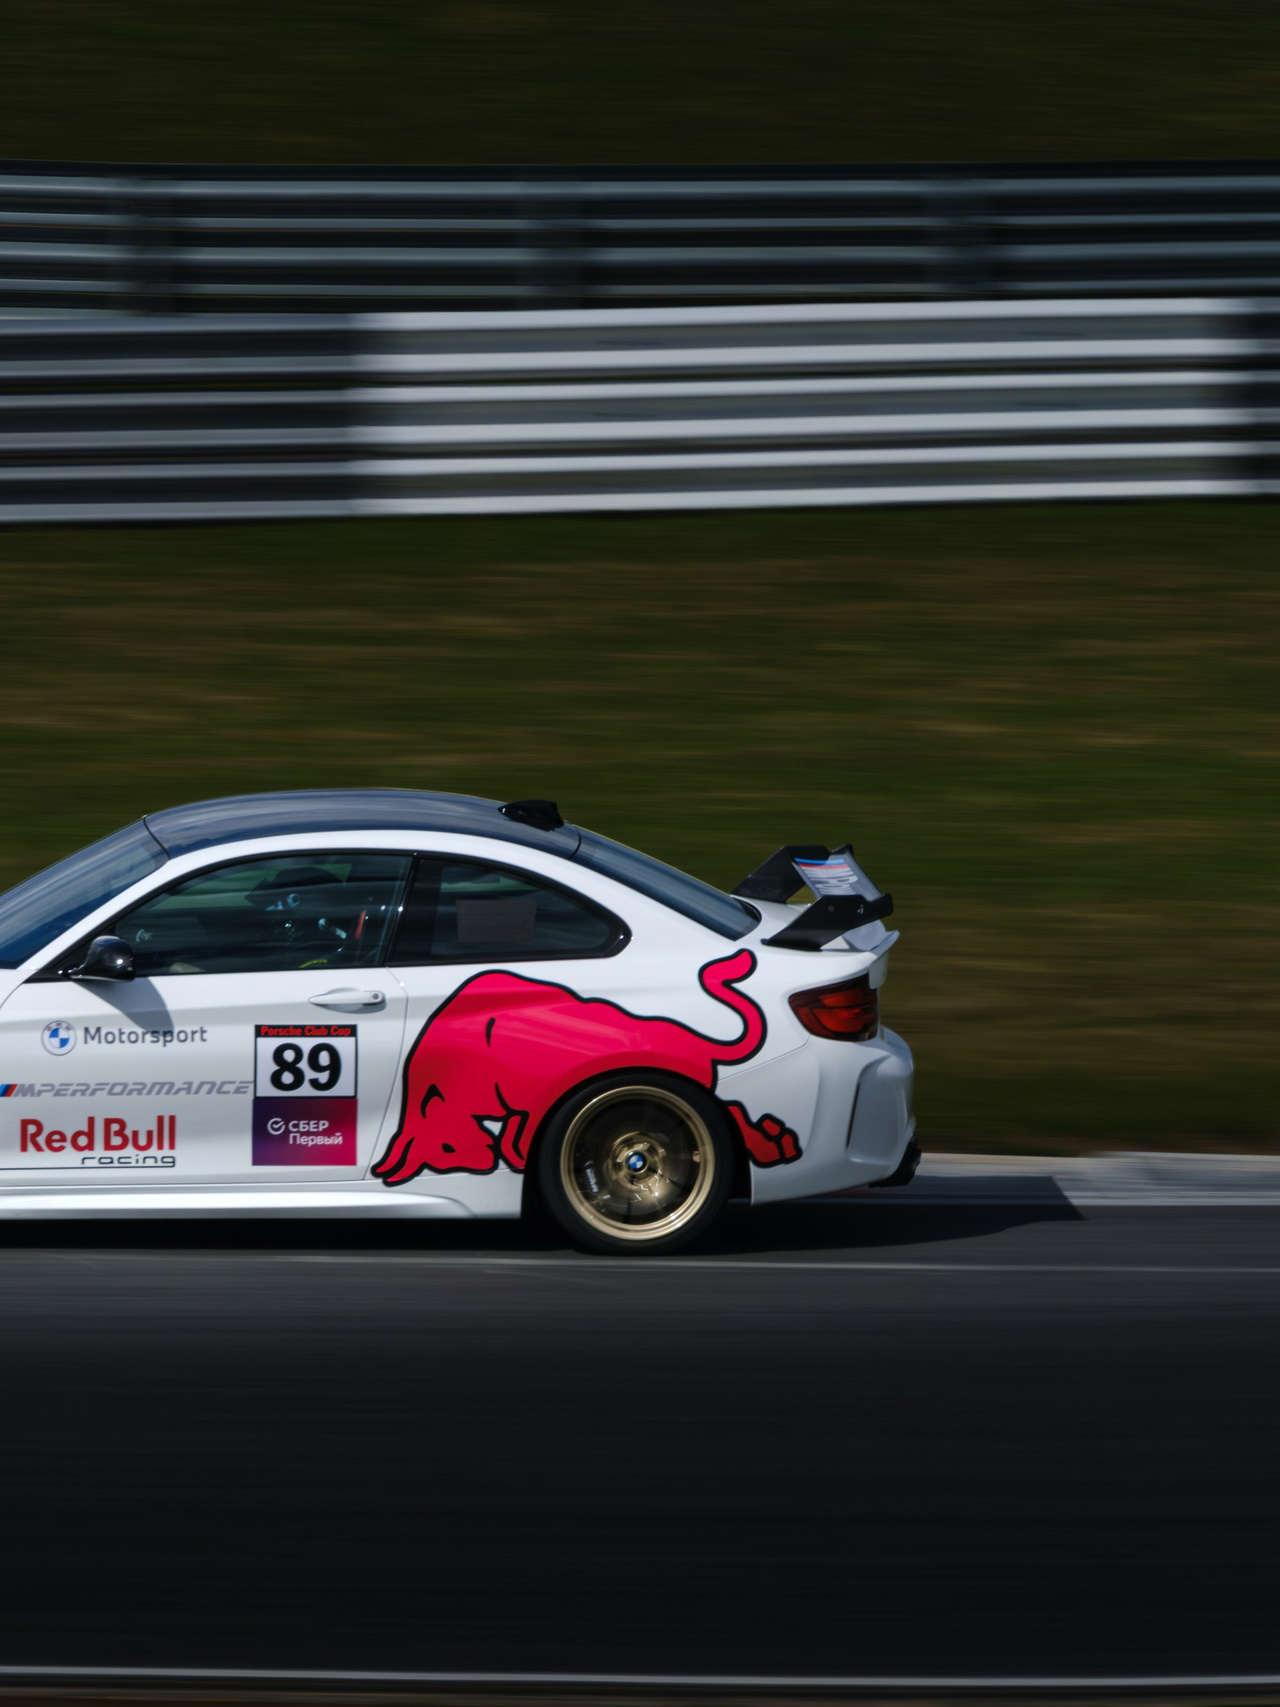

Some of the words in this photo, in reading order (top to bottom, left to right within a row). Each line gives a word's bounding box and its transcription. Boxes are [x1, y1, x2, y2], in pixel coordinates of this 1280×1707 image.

[83, 1026, 208, 1047] Motorsport
[260, 1026, 302, 1036] Porsche
[304, 1025, 328, 1036] Club
[330, 1025, 351, 1037] Cup
[270, 1042, 342, 1091] 89
[288, 1120, 329, 1132] СБЕР
[20, 1117, 95, 1153] Red
[104, 1115, 176, 1152] Bull
[289, 1132, 343, 1147] Первый
[81, 1154, 176, 1168] racing
